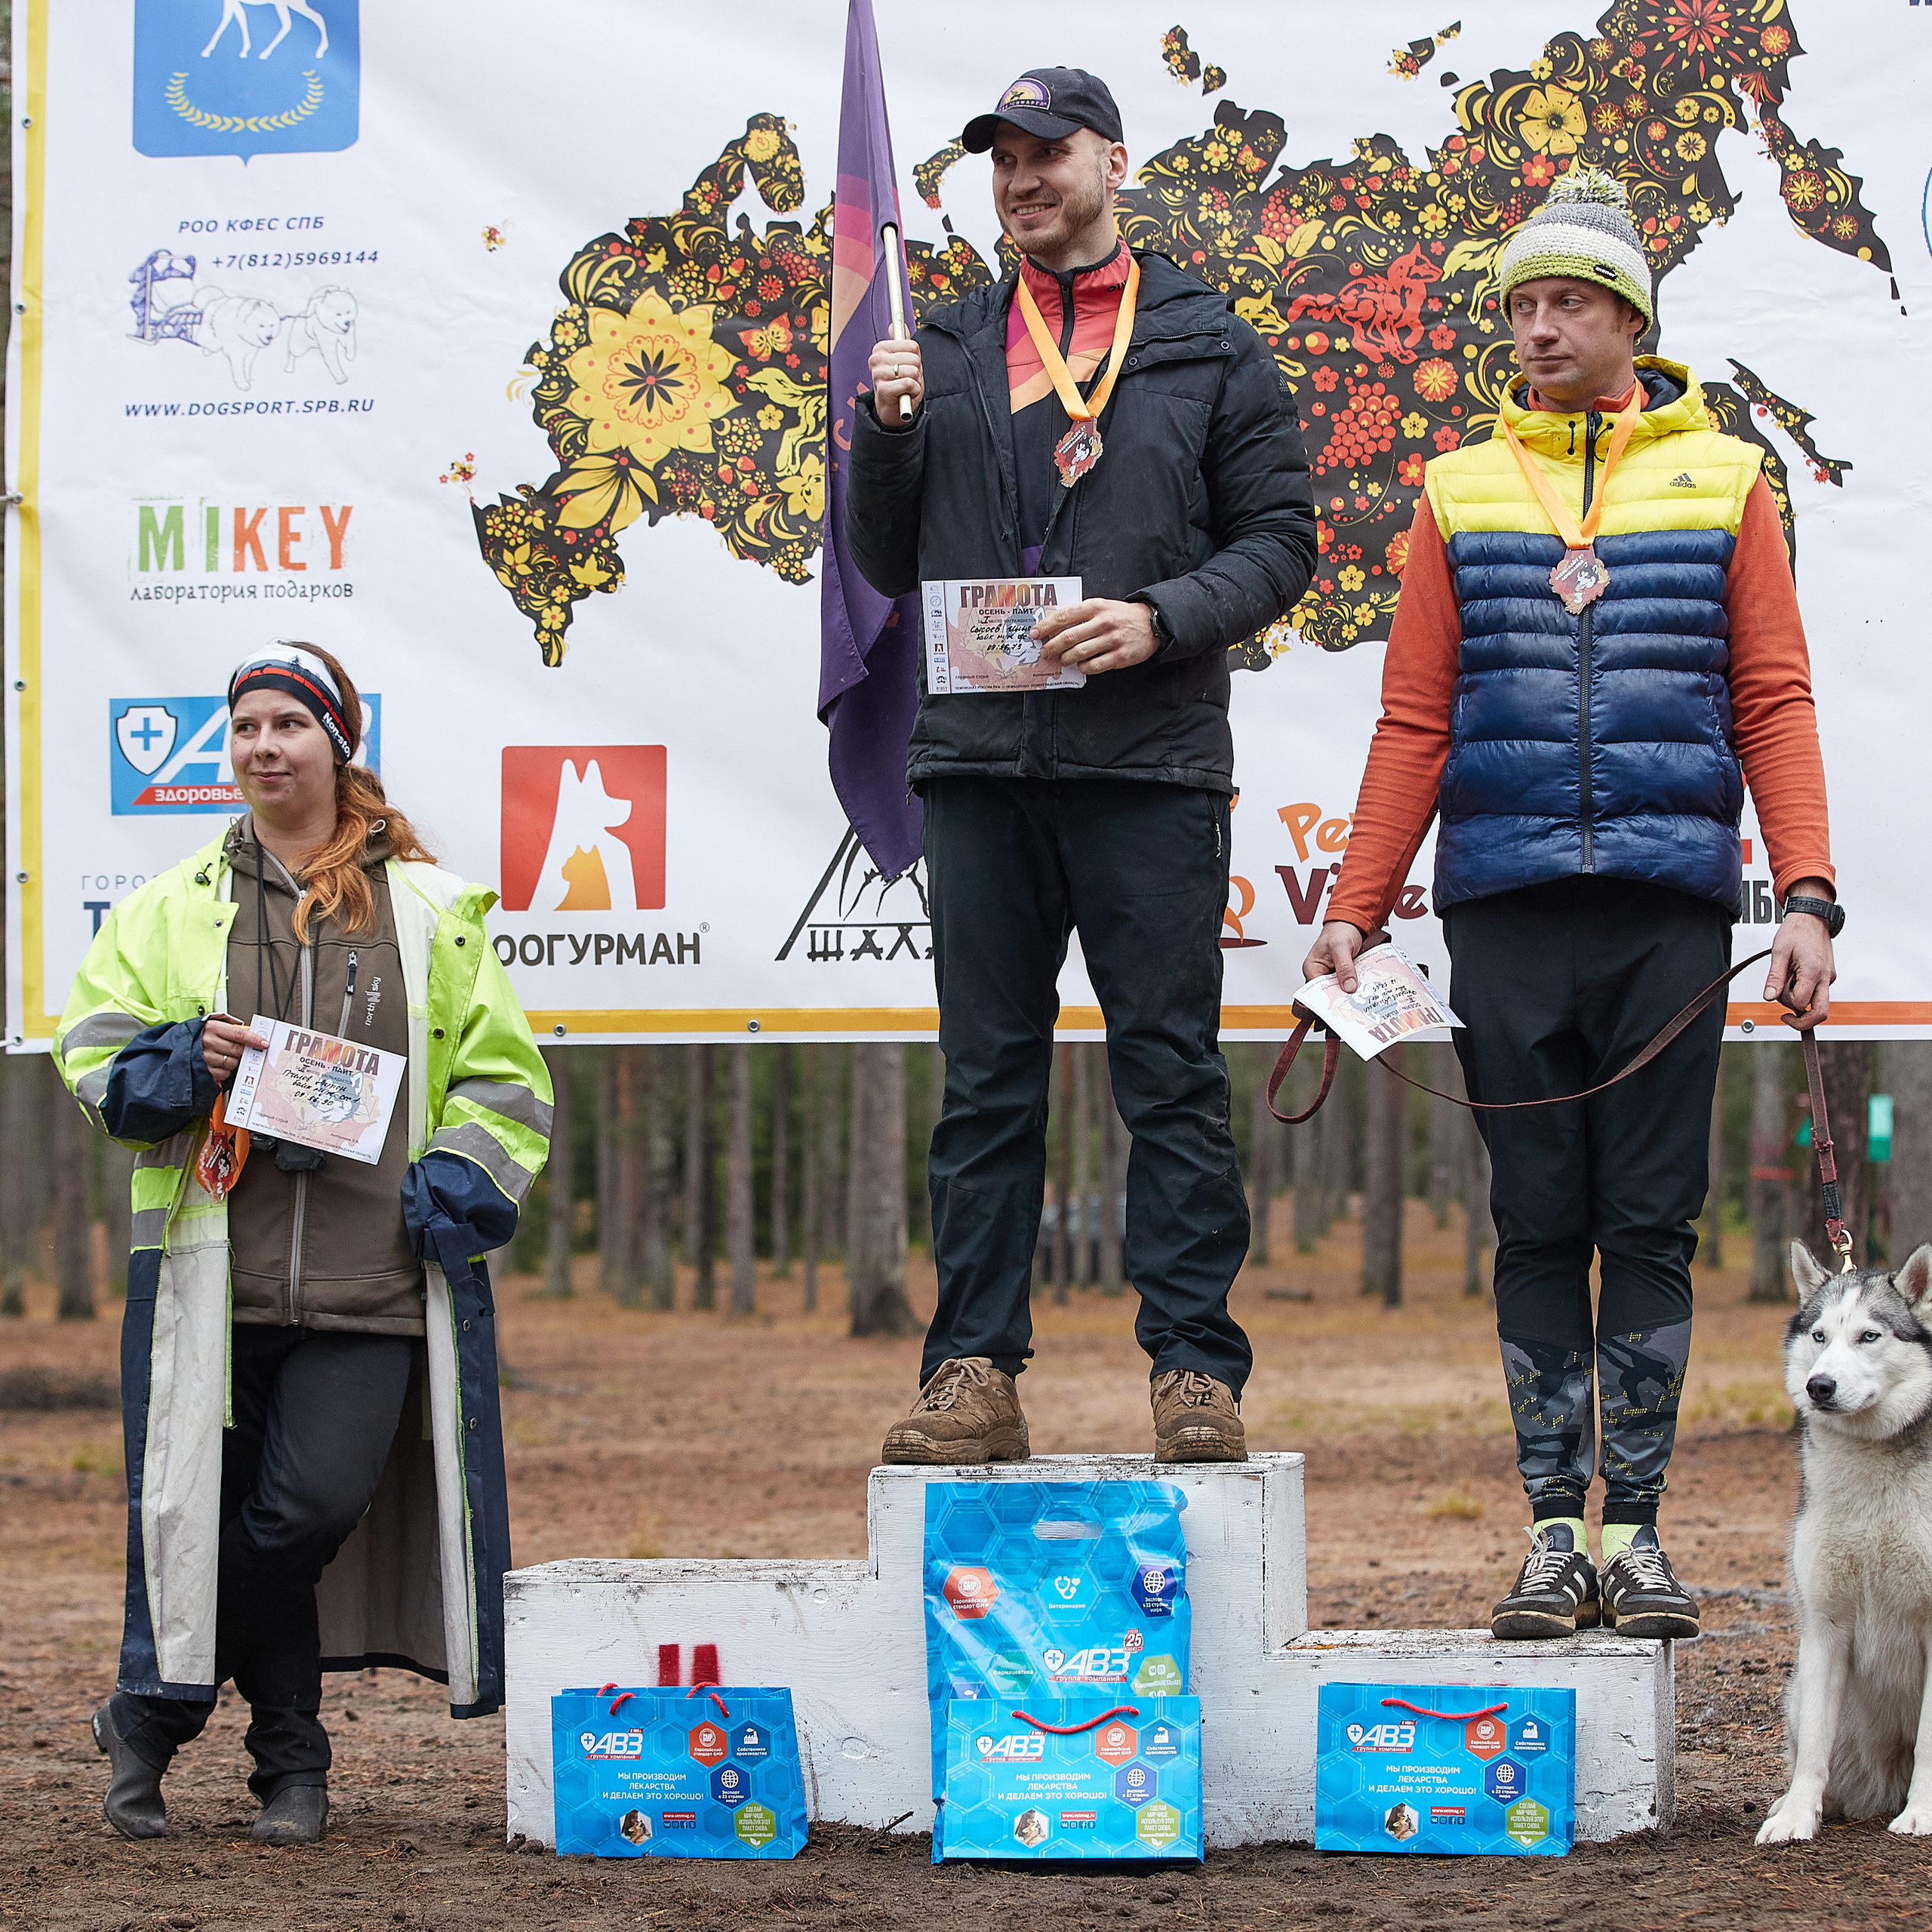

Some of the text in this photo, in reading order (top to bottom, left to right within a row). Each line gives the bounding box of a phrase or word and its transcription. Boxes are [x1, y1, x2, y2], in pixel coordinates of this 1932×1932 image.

[179, 217, 324, 233] РОО КФЕС СПБ
[212, 251, 378, 270] +7(812)5969144
[125, 399, 374, 416] WWW.DOGSPORT.SPB.RU
[1069, 465, 1076, 477] 1
[139, 506, 352, 572] MIKEY
[130, 580, 353, 604] лаборатория подарков
[961, 584, 1057, 608] ГРАМОТА
[1574, 592, 1583, 604] 3
[1277, 802, 1355, 863] Pe
[82, 875, 158, 890] ГОРО
[492, 933, 700, 966] ООГУРМАН
[808, 926, 934, 961] ШАЛ
[365, 977, 381, 1026] north sky
[1402, 1002, 1421, 1011] ОСЕНЬ
[1368, 1007, 1444, 1044] ГРАМОТА
[285, 1030, 380, 1075] ГРАМОТА
[300, 1057, 325, 1069] ОСЕНЬ
[217, 1182, 223, 1194] 2
[963, 1581, 977, 1591] GMP
[1126, 1633, 1142, 1647] 25
[1055, 1648, 1131, 1675] АВЗ
[589, 1733, 643, 1755] АВЗ
[1355, 1724, 1416, 1747] АВЗ
[985, 1736, 1045, 1757] АВЗ
[632, 1773, 686, 1781] ПРОИЗВОДИМ
[1402, 1766, 1460, 1774] ПРОИЗВОДИМ
[1435, 1786, 1476, 1795] ХОРОШО!
